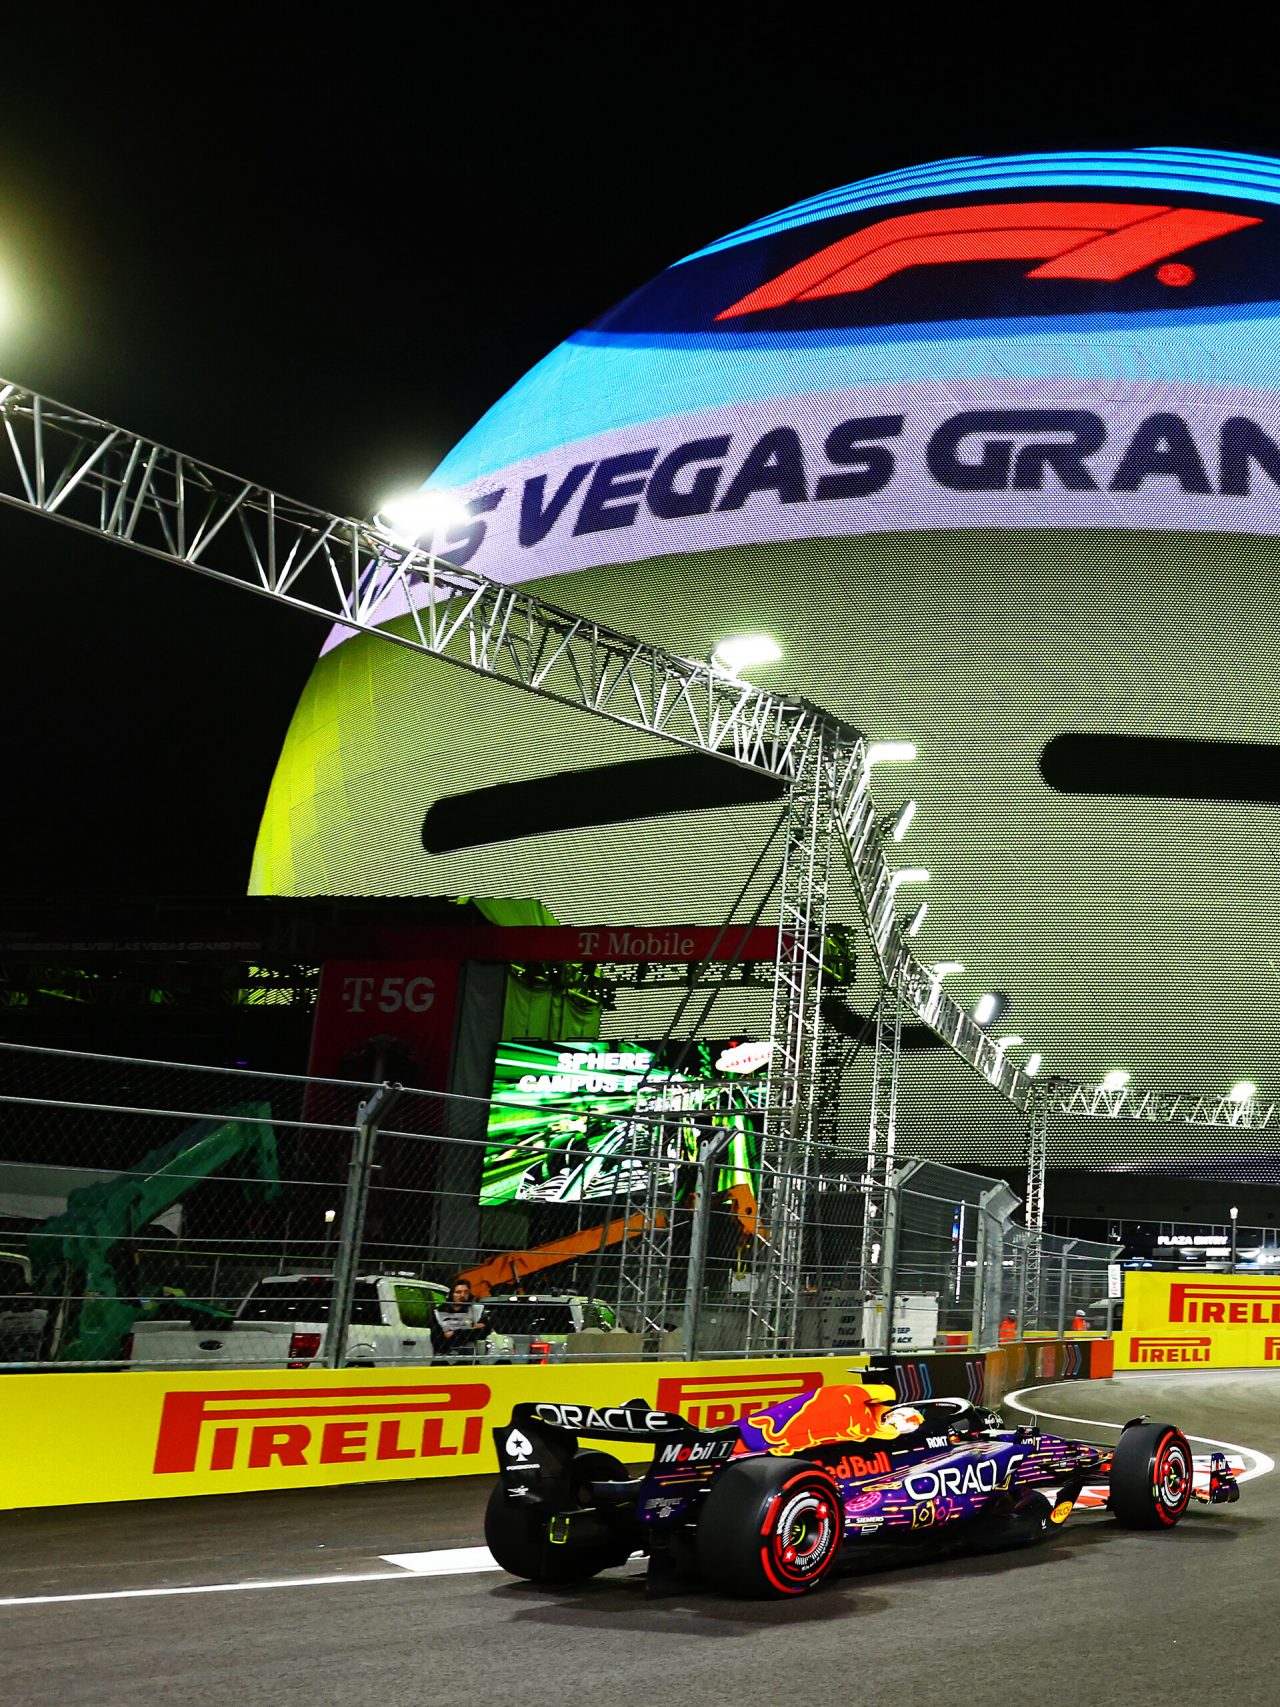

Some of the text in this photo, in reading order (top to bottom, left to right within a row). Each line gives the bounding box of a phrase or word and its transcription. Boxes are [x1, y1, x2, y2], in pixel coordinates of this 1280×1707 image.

[517, 414, 904, 549] VEGAS
[607, 931, 694, 956] Mobile
[377, 977, 435, 1013] 5G
[556, 1052, 651, 1071] SPHERE
[519, 1075, 618, 1093] CAMPUS
[1157, 1236, 1228, 1245] PLAZA ENTRY
[1130, 1337, 1210, 1363] PIRELLI
[152, 1383, 491, 1475] PIRELLI
[535, 1403, 669, 1432] ORACLE
[659, 1440, 716, 1464] Mobil
[812, 1450, 893, 1480] ed Bull
